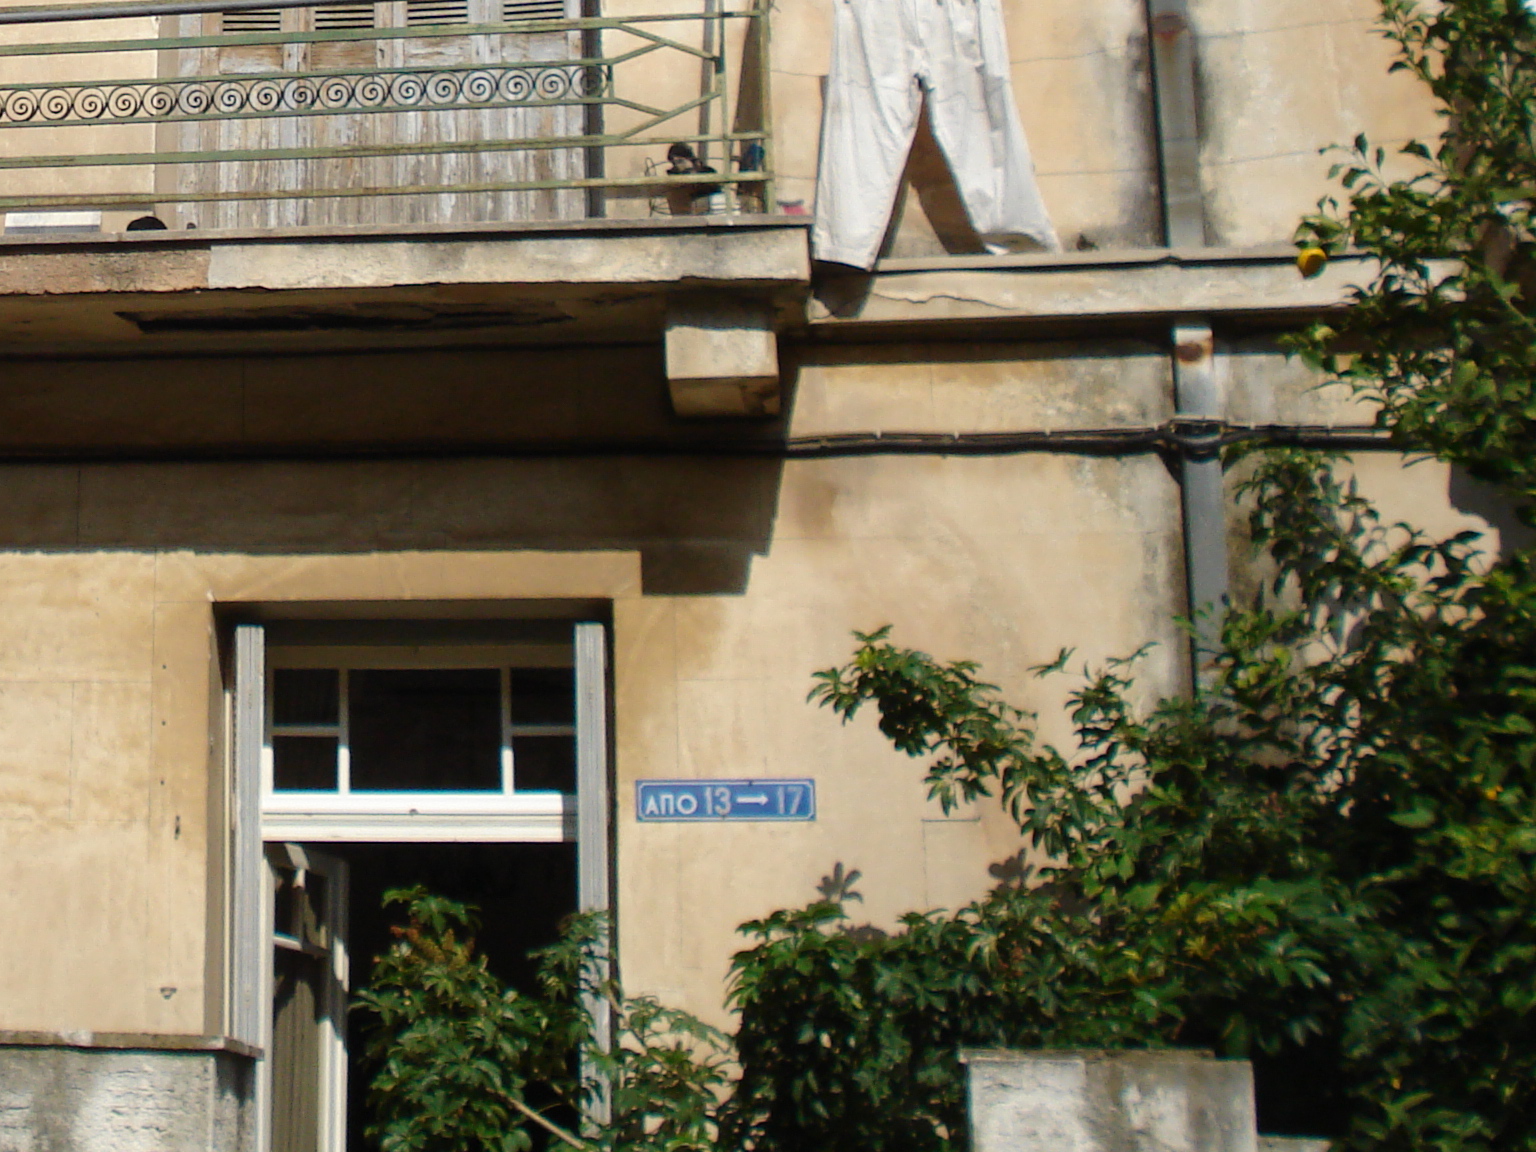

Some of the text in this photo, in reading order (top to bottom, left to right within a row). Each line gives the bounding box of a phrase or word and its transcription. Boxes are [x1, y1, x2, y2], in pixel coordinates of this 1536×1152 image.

[645, 786, 804, 815] ΑΠΟ 13 17
